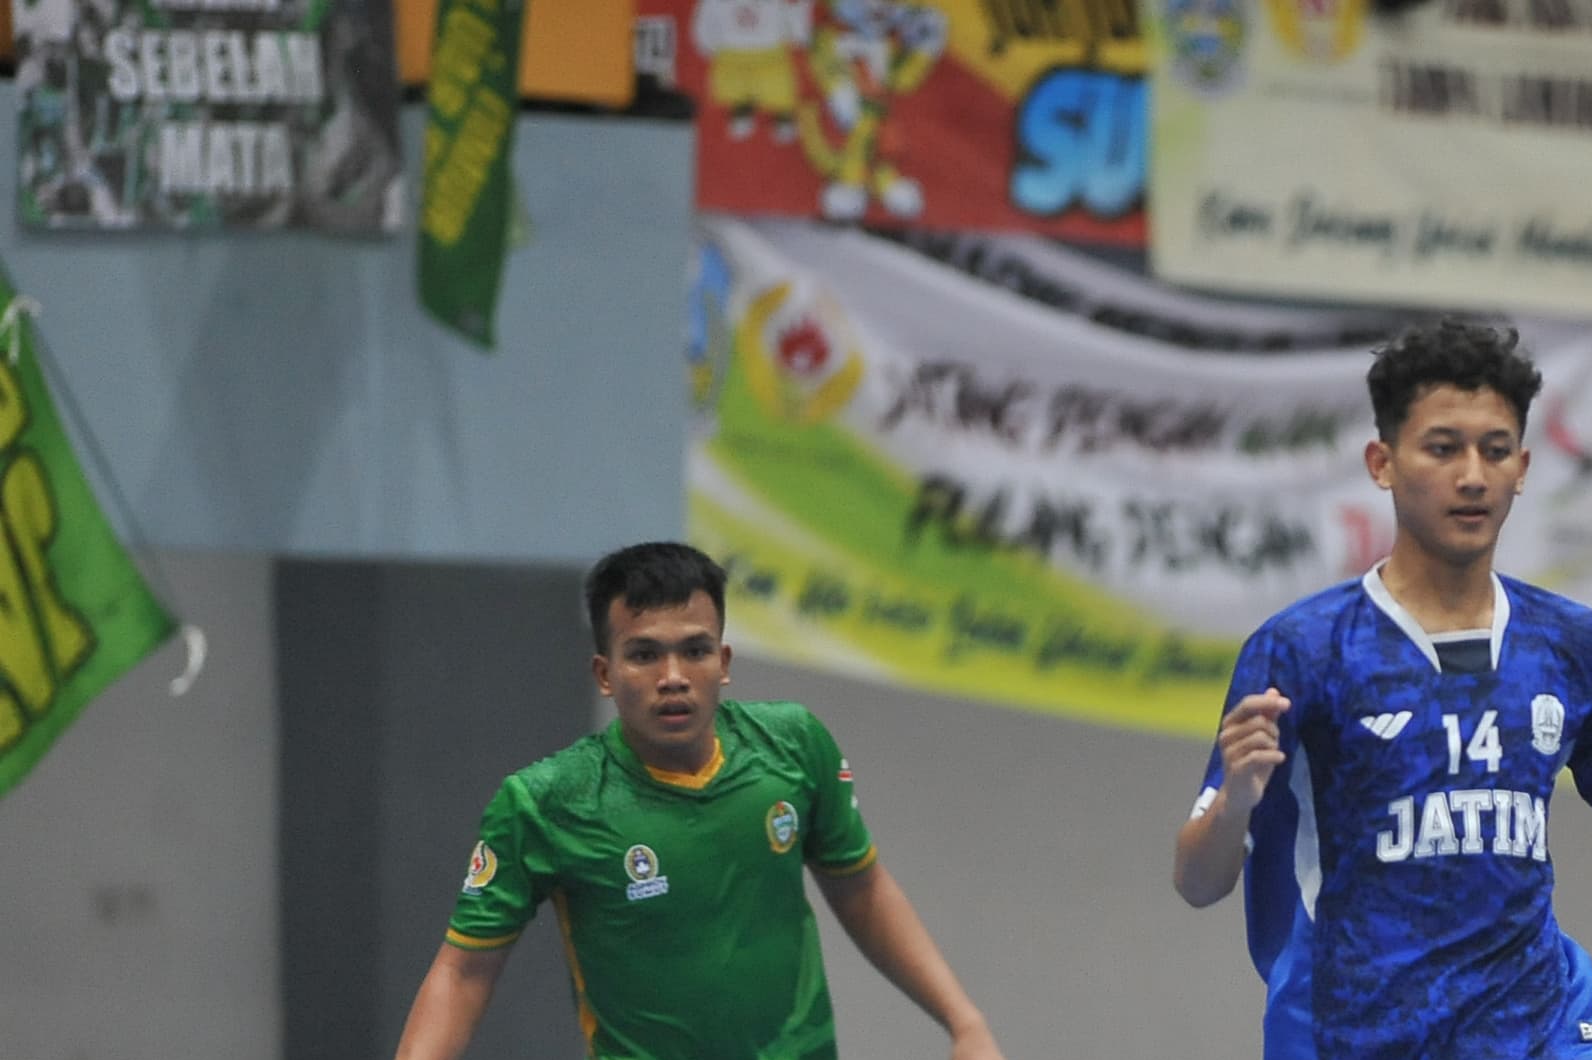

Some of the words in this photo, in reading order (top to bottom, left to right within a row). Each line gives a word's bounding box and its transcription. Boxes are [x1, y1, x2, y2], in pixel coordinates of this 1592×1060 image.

[104, 27, 323, 100] SEBELAH
[156, 121, 294, 193] MATA
[1441, 709, 1503, 775] 14
[1375, 788, 1548, 862] JATIM
